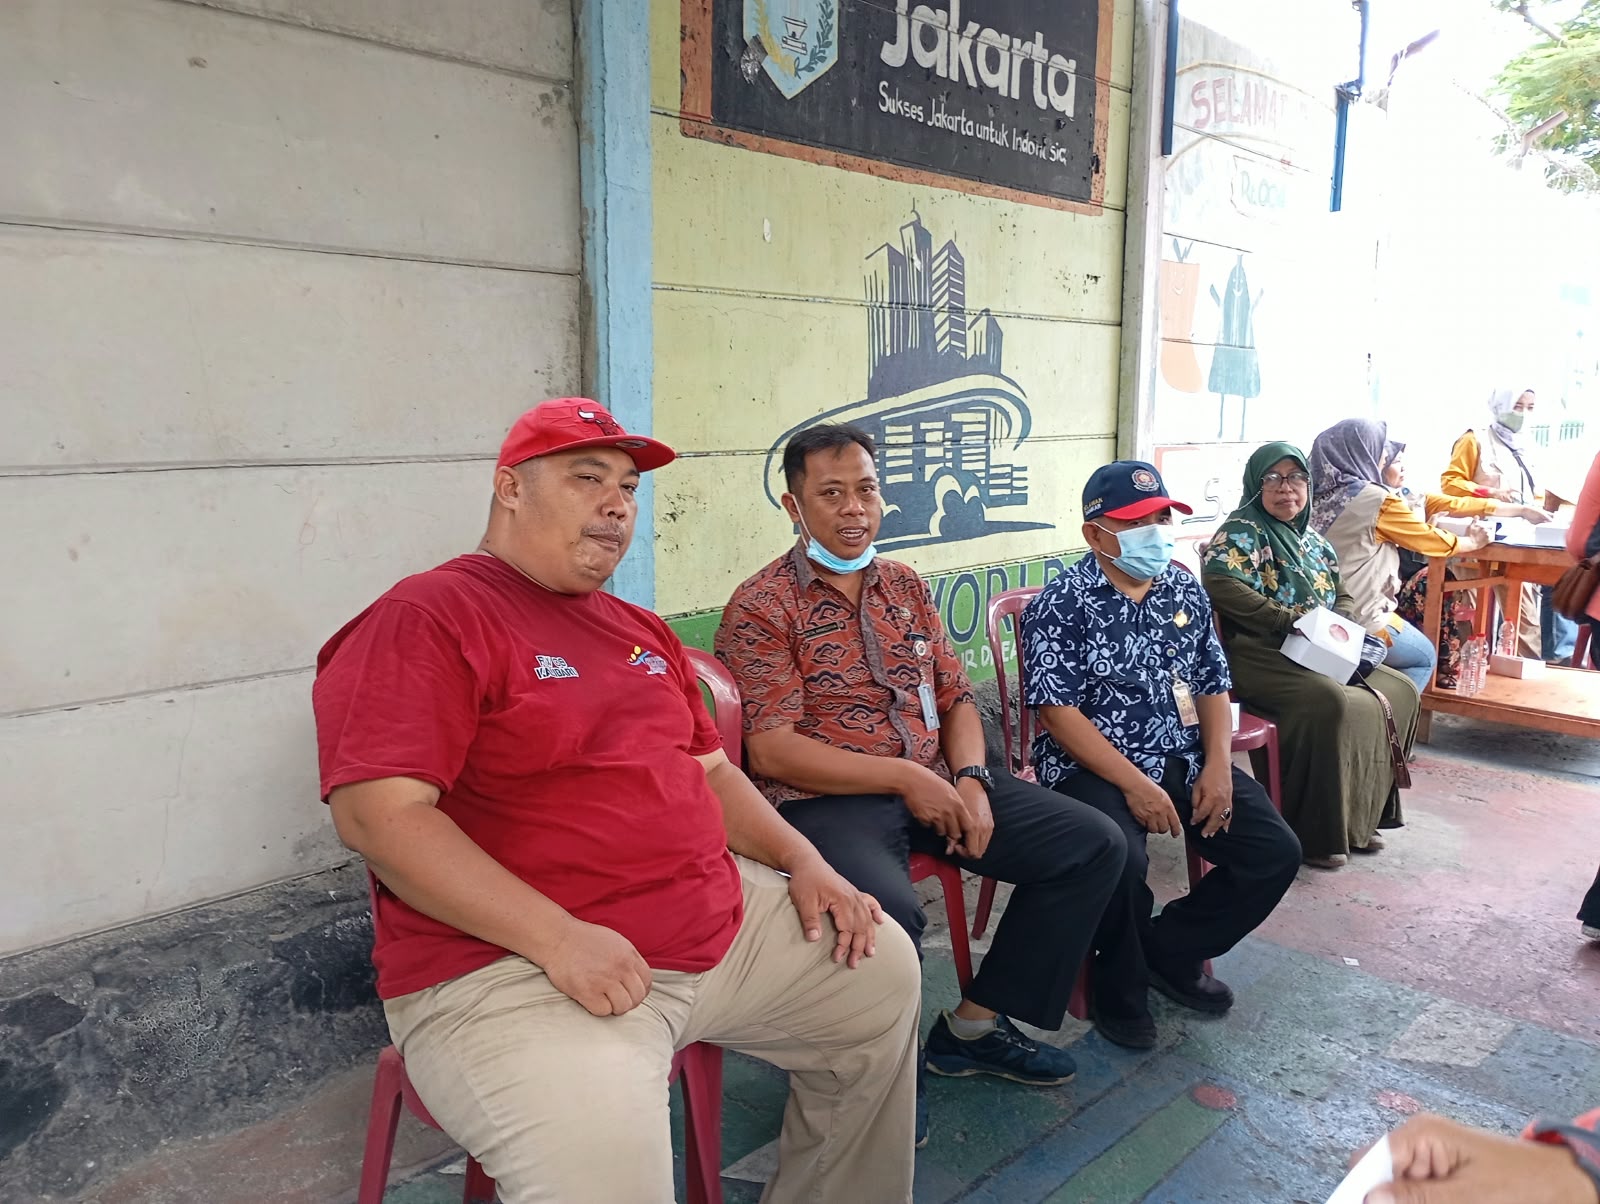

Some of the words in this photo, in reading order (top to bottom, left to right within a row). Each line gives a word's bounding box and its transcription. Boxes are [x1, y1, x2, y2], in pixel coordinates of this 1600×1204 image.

[880, 0, 1076, 117] Jakarta
[879, 80, 923, 122] Sukses
[927, 98, 973, 136] Jakarta
[976, 120, 1009, 147] untuk
